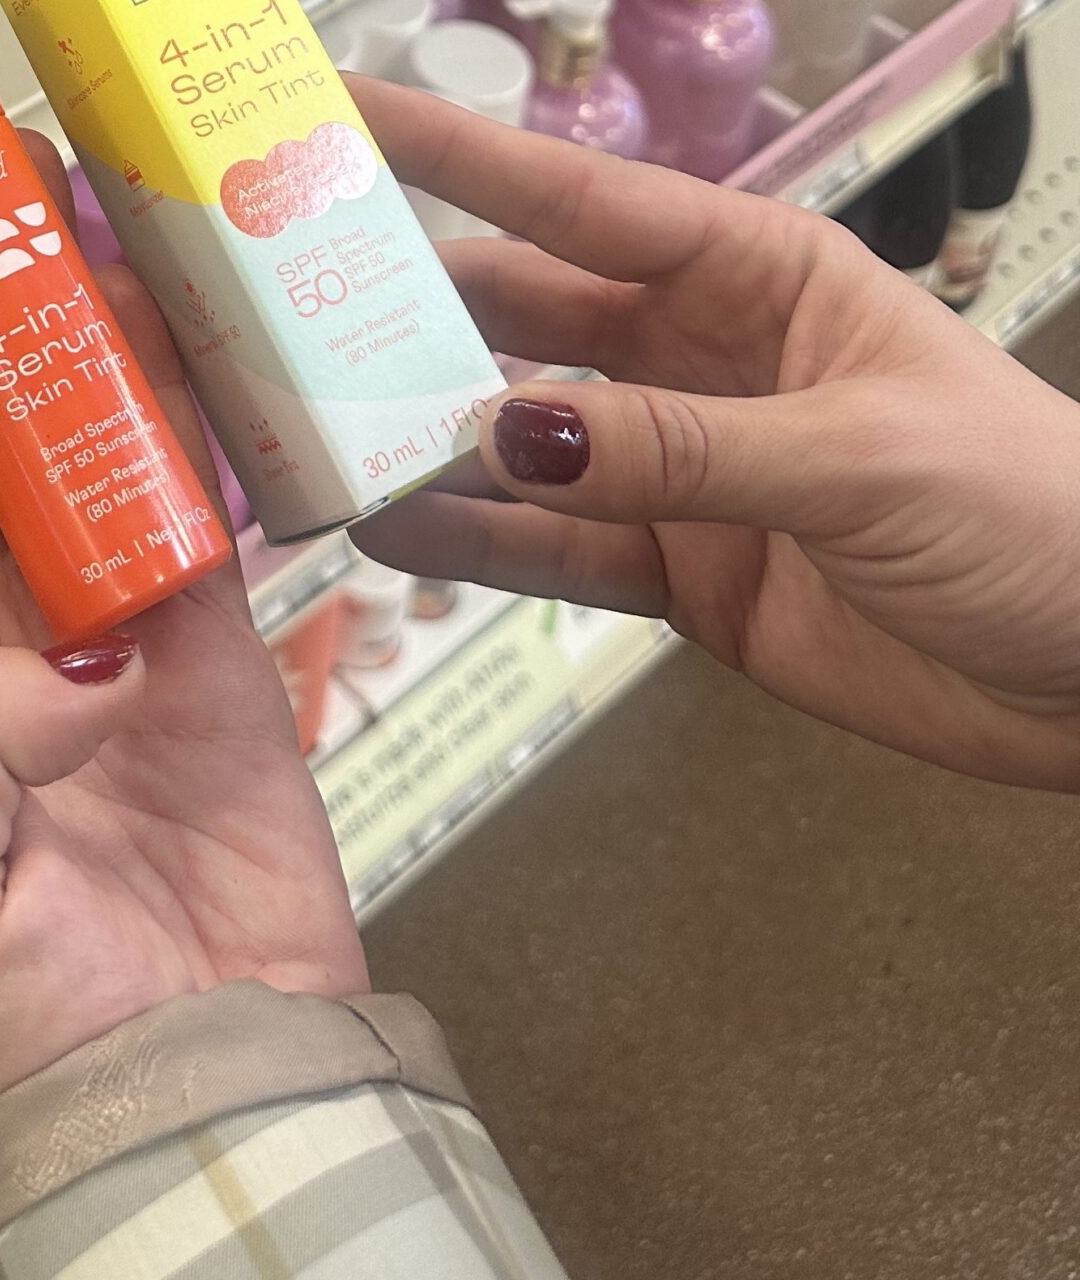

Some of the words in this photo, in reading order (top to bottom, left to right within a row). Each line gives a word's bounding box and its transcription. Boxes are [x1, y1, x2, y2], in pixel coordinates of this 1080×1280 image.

[171, 36, 310, 105] Serum
[190, 96, 259, 138] Skin
[260, 69, 326, 106] Tint
[328, 225, 366, 250] Broad
[336, 230, 395, 265] Spectrum
[276, 245, 328, 284] SPF
[344, 260, 368, 279] SPF
[368, 251, 385, 267] 50
[351, 256, 414, 293] Sunscreen
[287, 269, 348, 318] 50
[325, 325, 365, 353] Water
[364, 299, 421, 333] Resistant
[345, 345, 368, 367] (80
[367, 318, 421, 354] Minutes)
[6, 378, 74, 421] Skin
[73, 351, 127, 382] Tint
[40, 430, 84, 463] Broad
[45, 459, 73, 484] SPF
[74, 448, 95, 469] 50
[363, 450, 391, 480] 30
[393, 436, 424, 465] mL
[439, 417, 453, 437] 1
[451, 406, 472, 432] Fl
[64, 477, 111, 508] Water
[85, 498, 113, 523] (80
[113, 470, 171, 507] Minutes)
[80, 561, 104, 585] 30
[105, 549, 132, 572] mL
[195, 506, 211, 523] Oz
